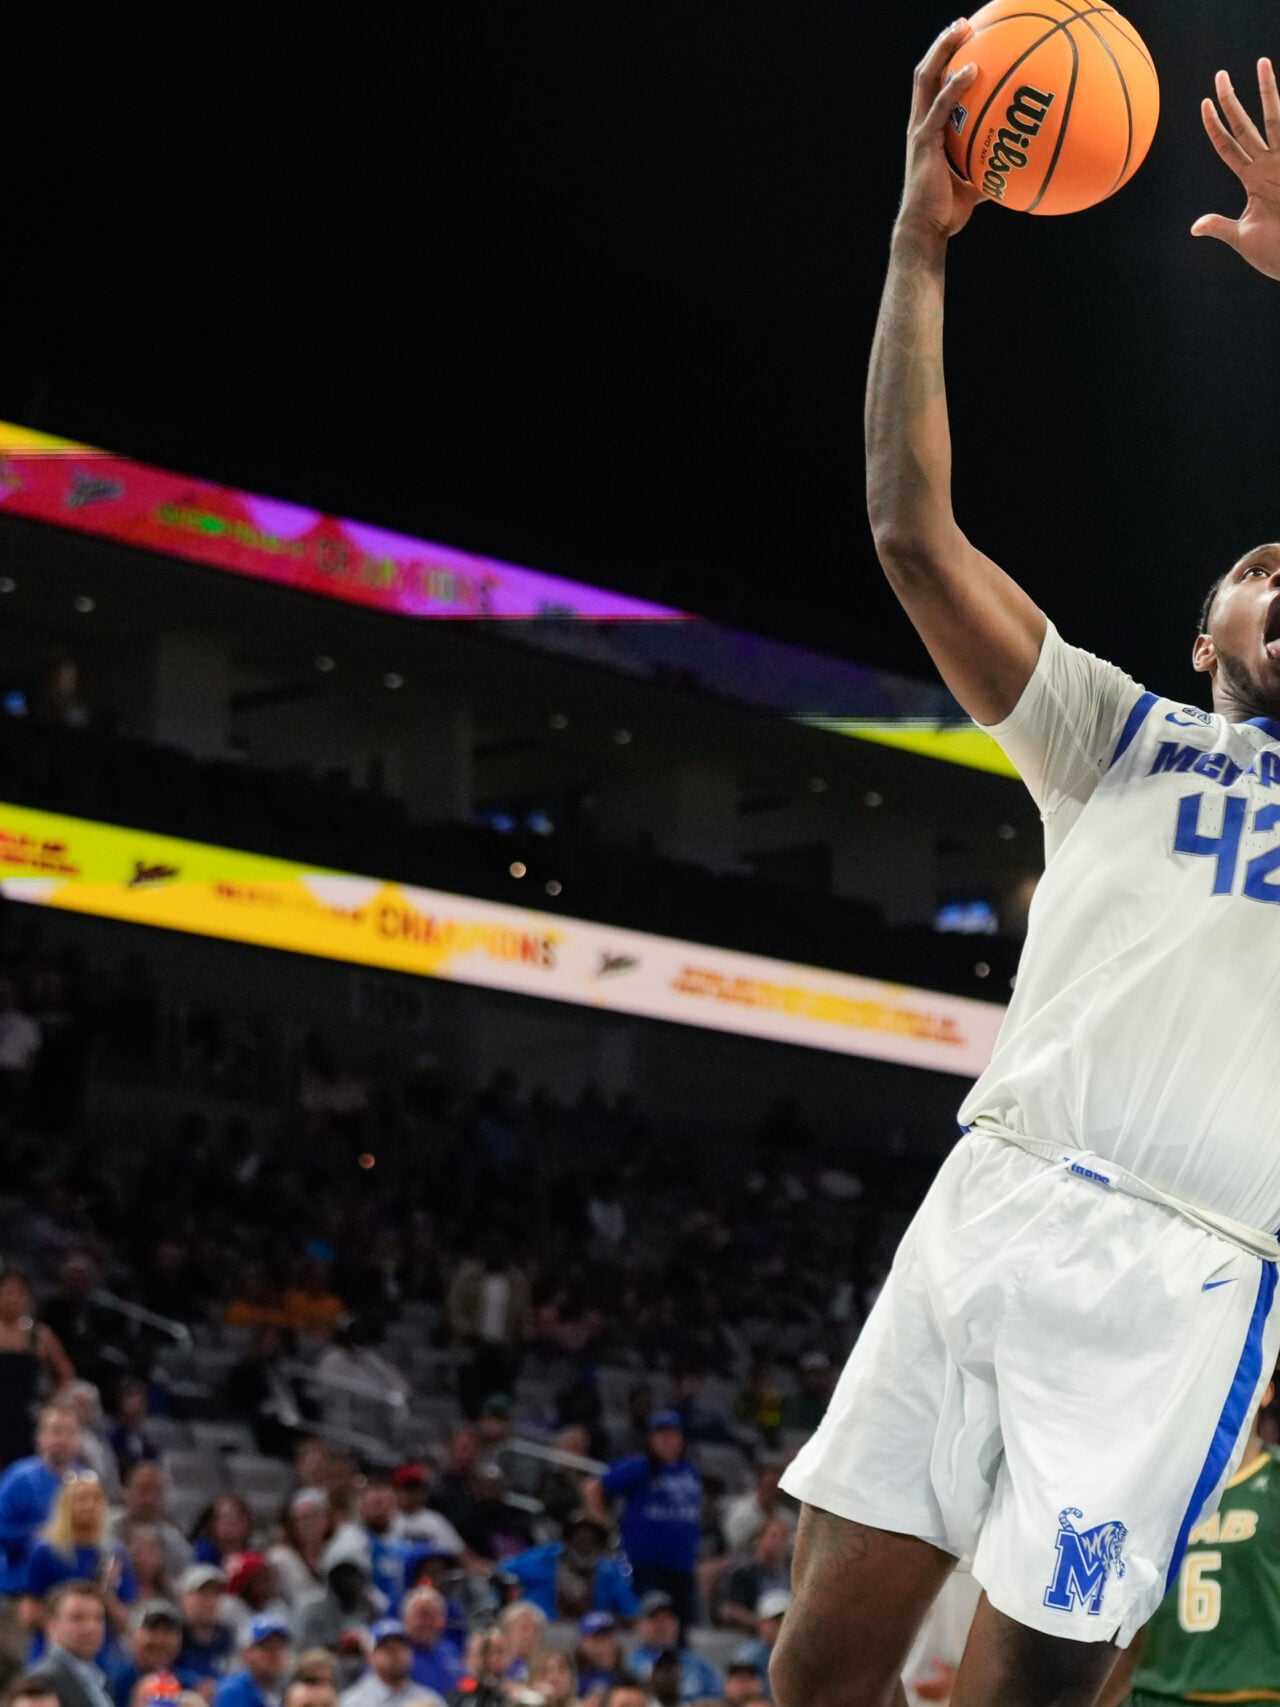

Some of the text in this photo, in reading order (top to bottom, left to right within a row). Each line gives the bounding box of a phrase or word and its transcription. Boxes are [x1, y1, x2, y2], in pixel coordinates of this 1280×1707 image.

[983, 85, 1055, 200] Wilson
[1188, 1509, 1259, 1544] AB
[1178, 1551, 1222, 1633] 6
